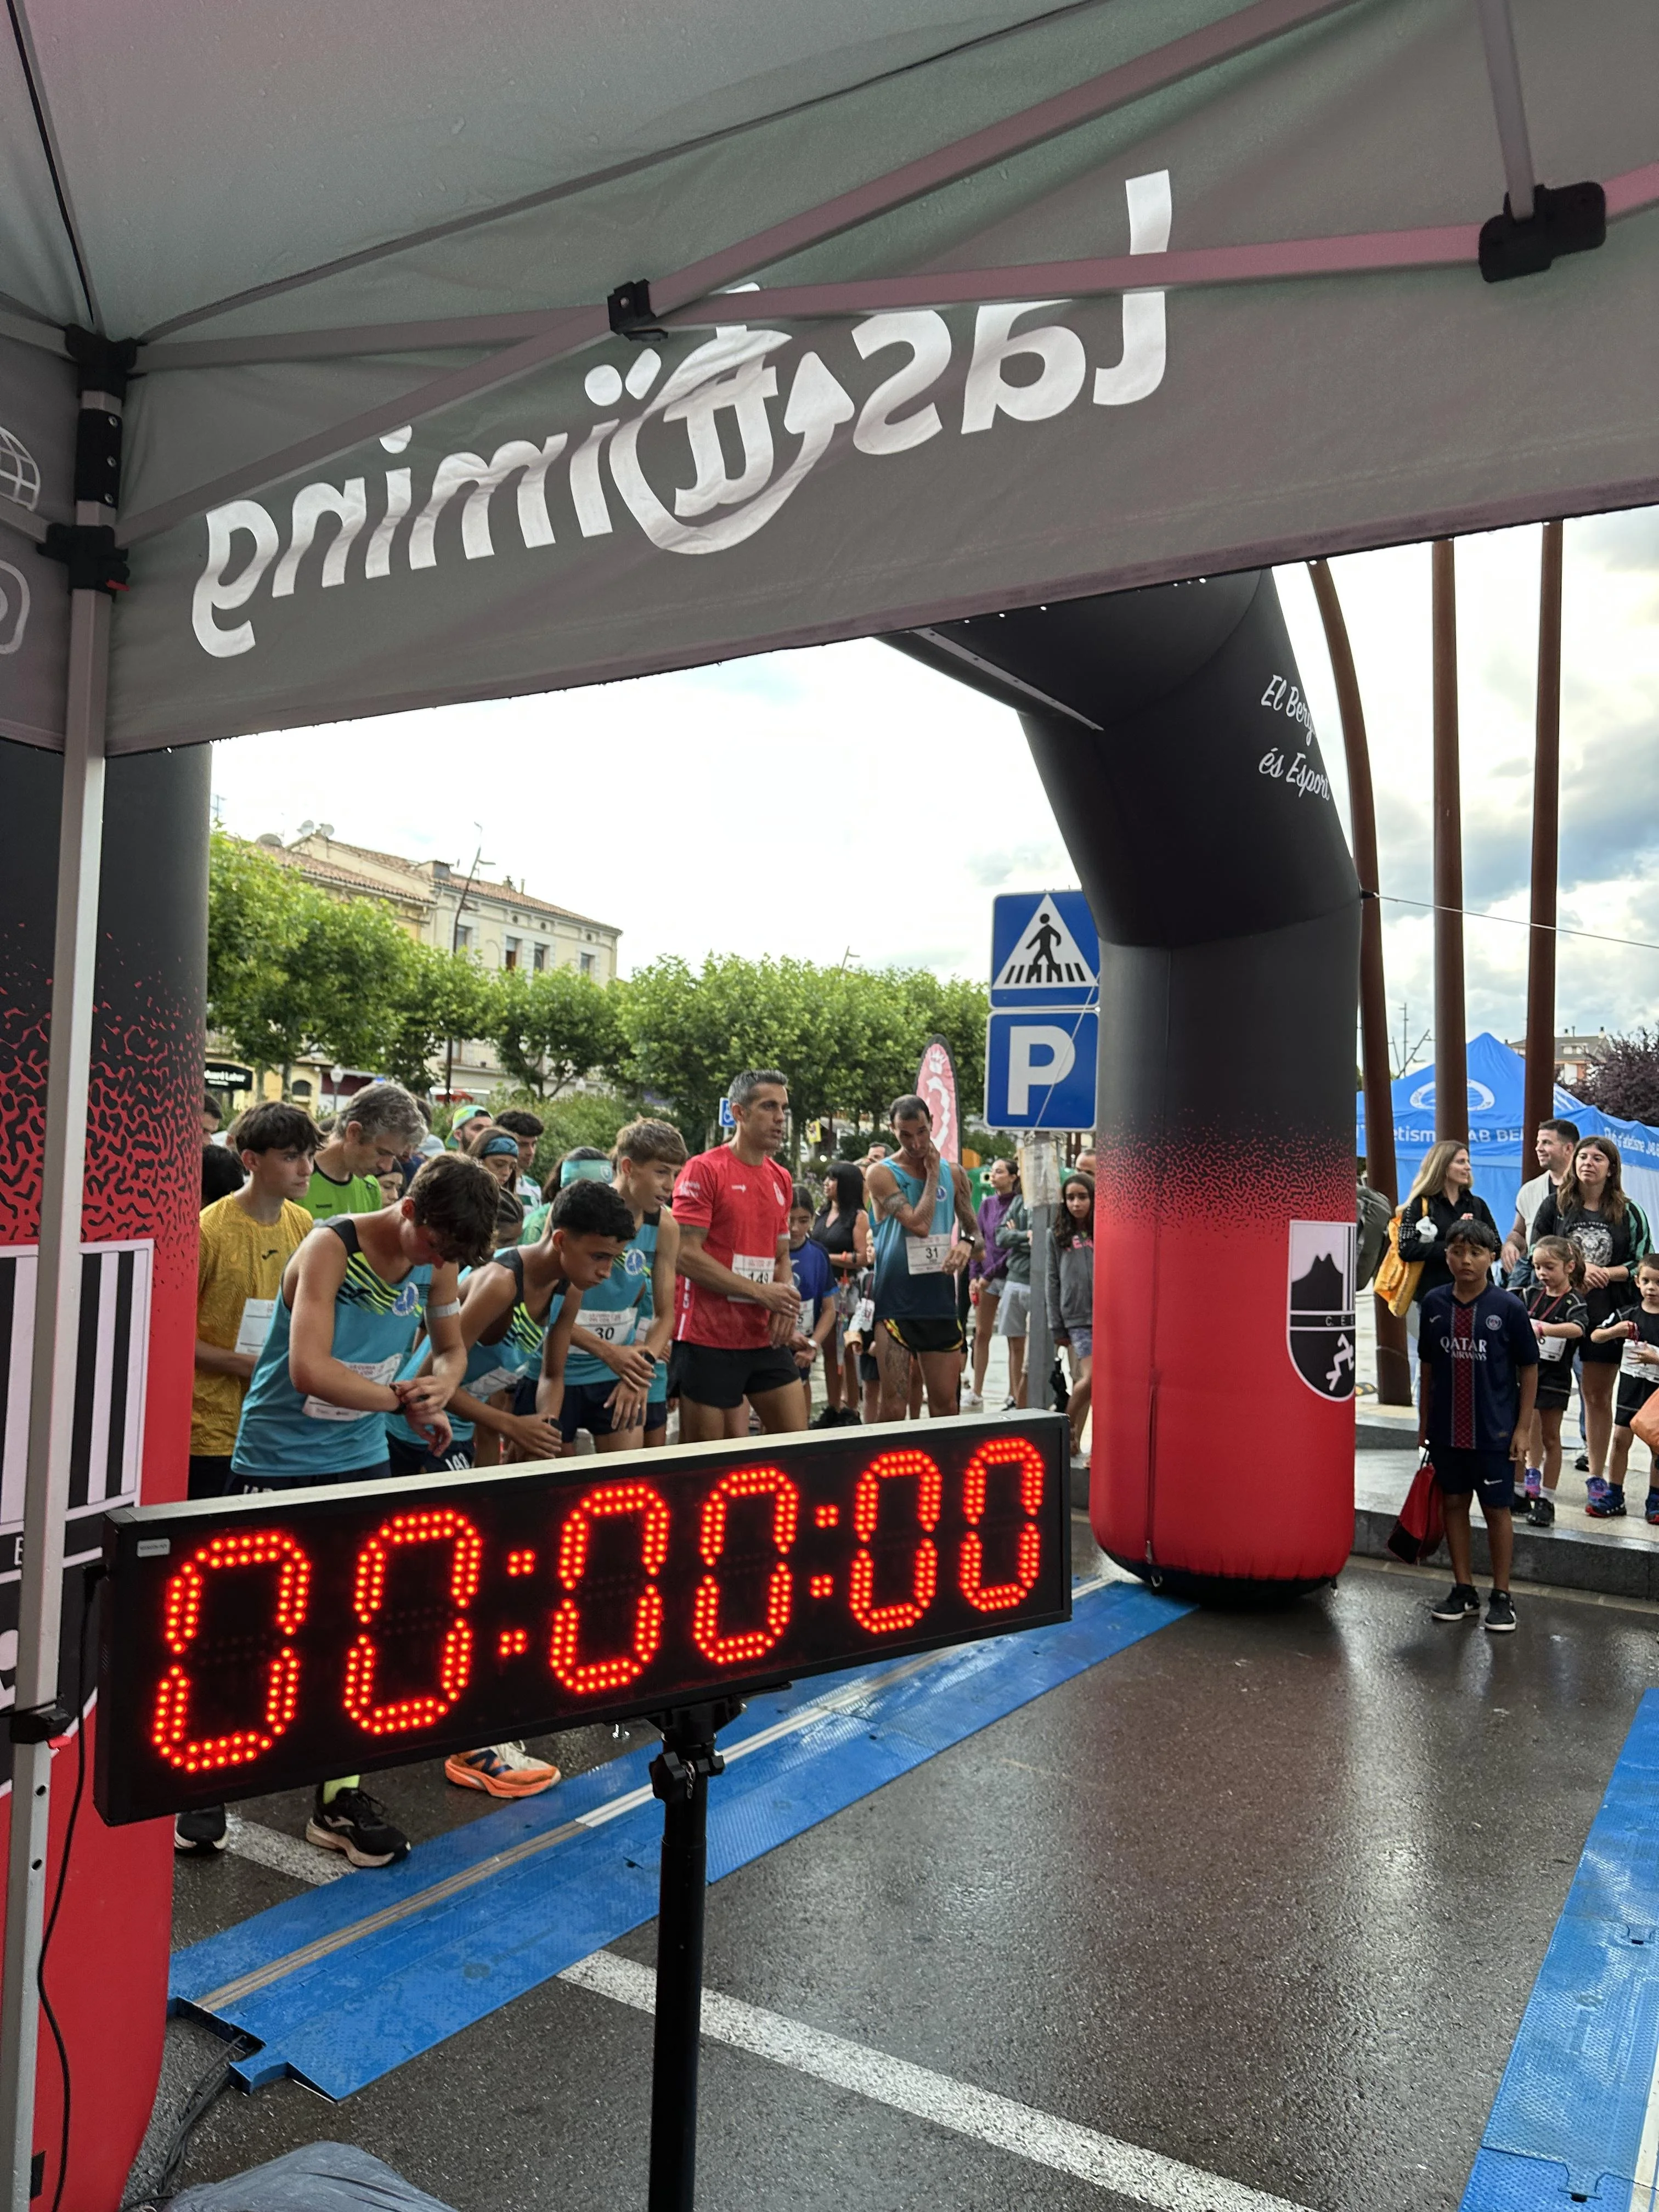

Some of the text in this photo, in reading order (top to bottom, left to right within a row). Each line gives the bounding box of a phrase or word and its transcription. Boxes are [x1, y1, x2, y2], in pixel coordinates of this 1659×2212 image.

[1261, 674, 1317, 747] El Berg
[1259, 747, 1285, 778] és
[1007, 1025, 1076, 1116] P
[1468, 1128, 1491, 1143] AB
[926, 1247, 939, 1260] 31
[595, 1327, 615, 1340] 30
[1440, 1336, 1488, 1353] QATAR
